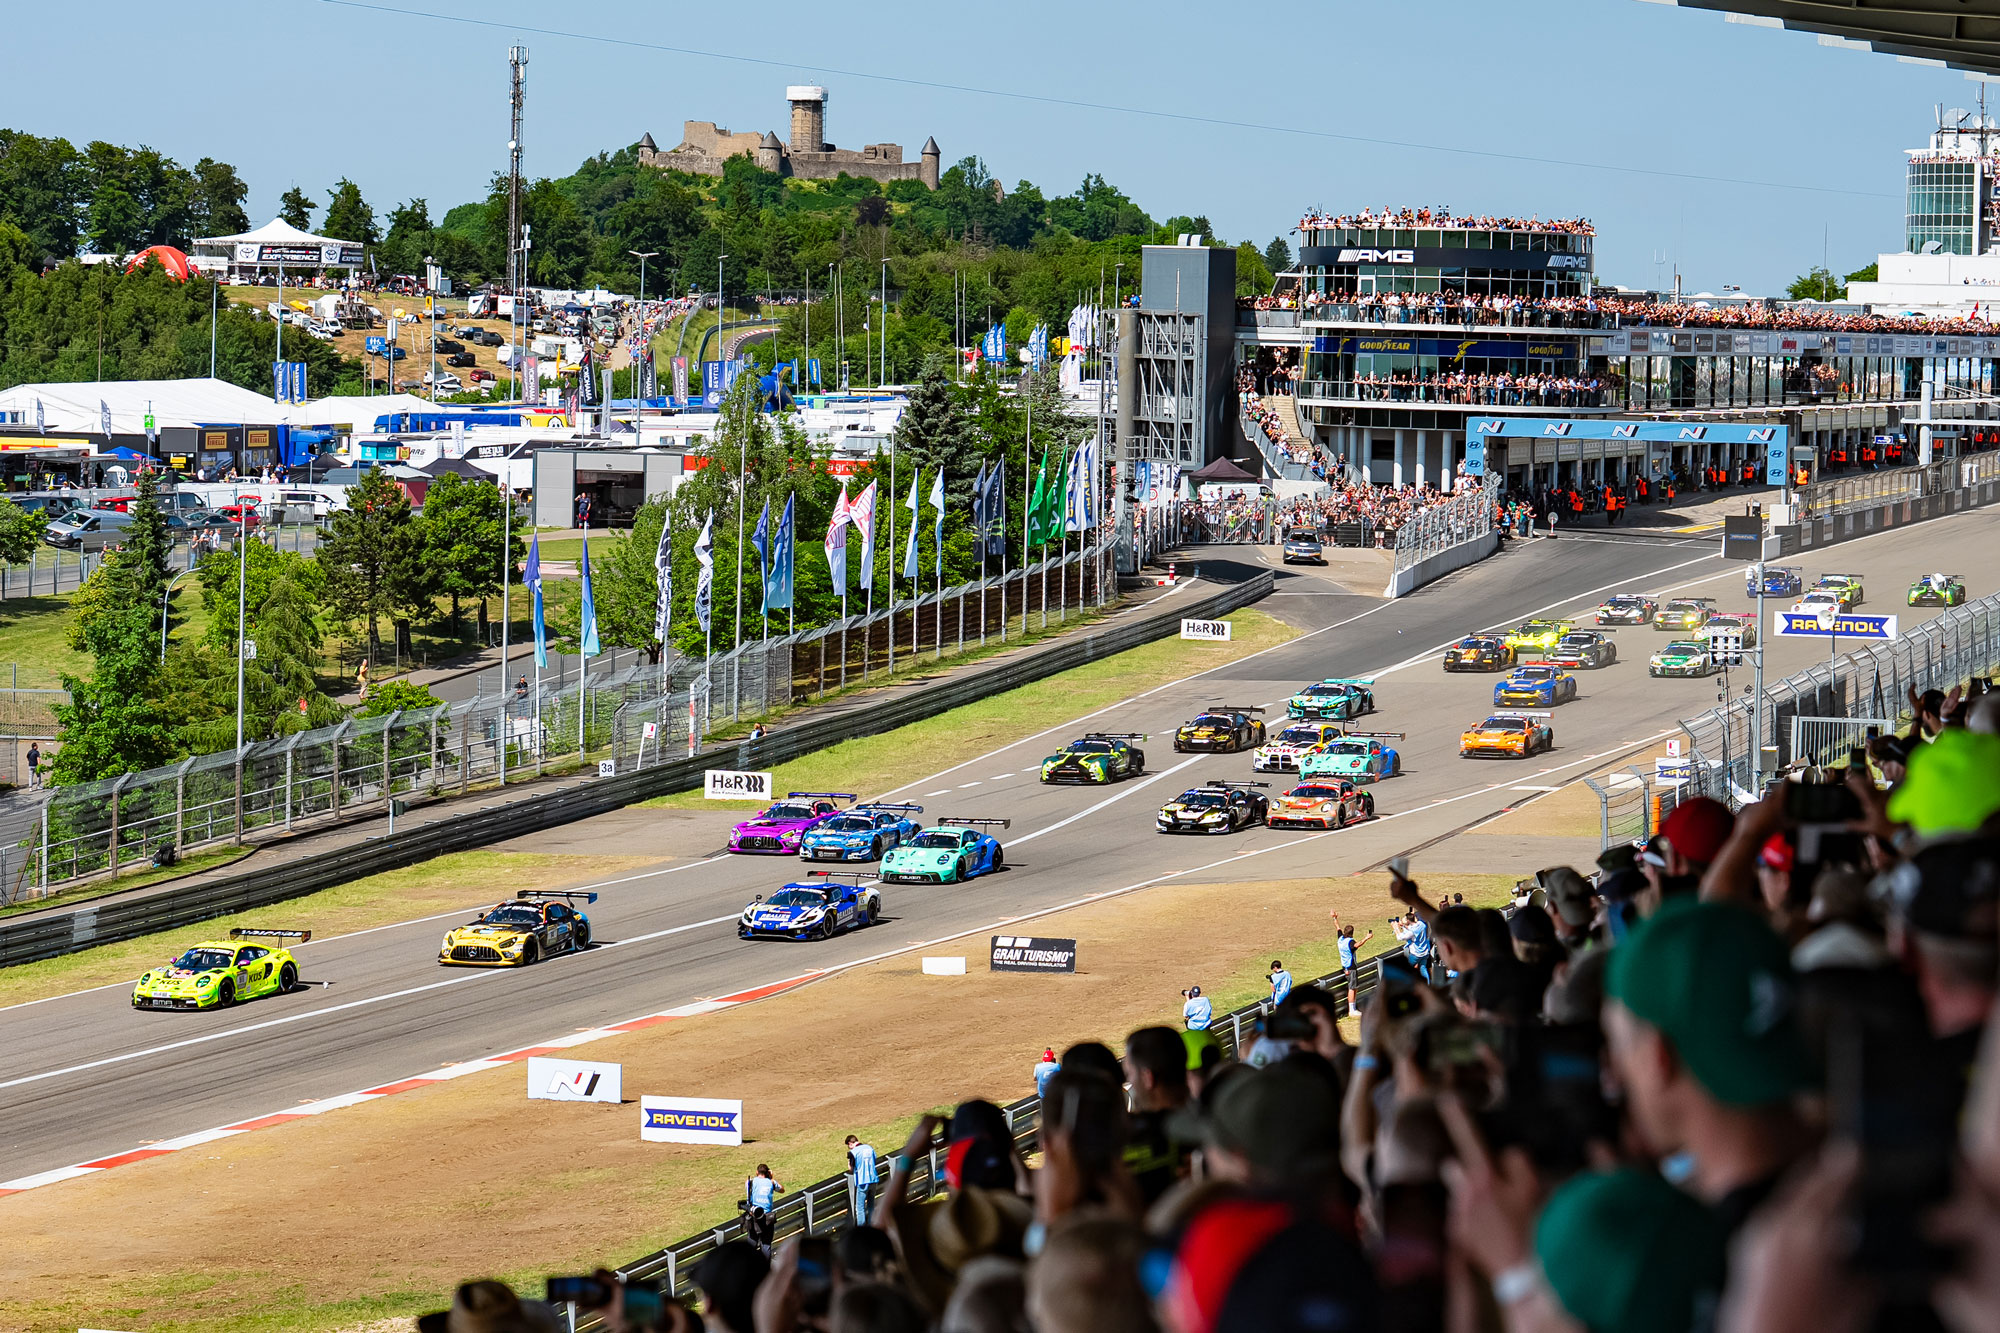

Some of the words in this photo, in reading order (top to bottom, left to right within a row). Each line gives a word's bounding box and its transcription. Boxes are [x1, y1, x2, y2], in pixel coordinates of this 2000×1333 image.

[1354, 250, 1414, 263] AMG
[1562, 255, 1587, 269] AMG
[1359, 340, 1410, 351] GOODYEAR
[1529, 345, 1563, 355] GOODYEAR
[528, 367, 536, 401] YOKOHAMA
[583, 363, 592, 401] YOKOHAMA
[207, 435, 225, 446] PIRELLI
[250, 433, 268, 444] PIRELLI
[1186, 622, 1210, 634] H&R
[1791, 619, 1880, 633] RAENOL
[601, 762, 613, 773] 3a
[713, 774, 744, 790] H&R
[993, 948, 1022, 961] GRAN
[652, 1113, 730, 1129] RAVENOL
